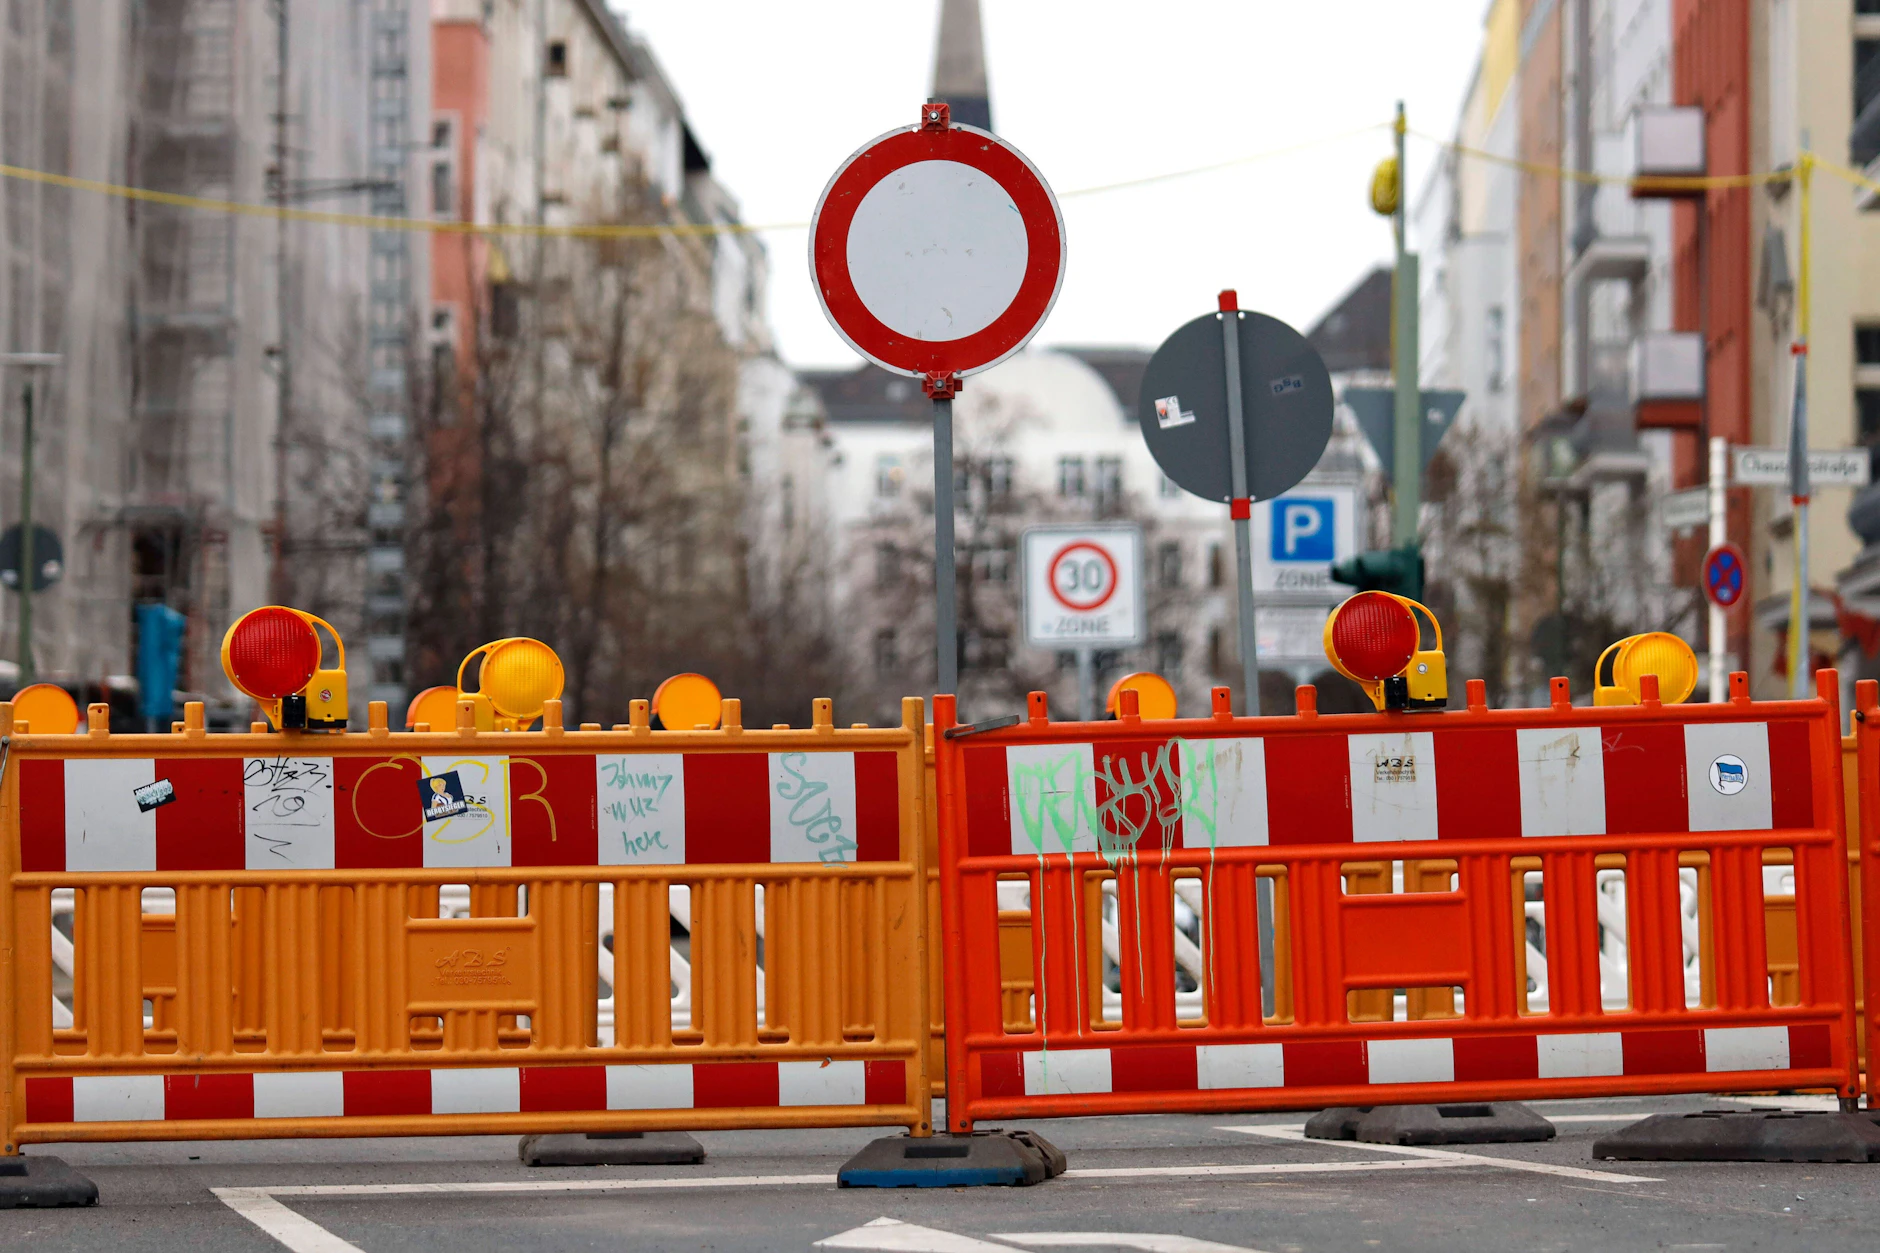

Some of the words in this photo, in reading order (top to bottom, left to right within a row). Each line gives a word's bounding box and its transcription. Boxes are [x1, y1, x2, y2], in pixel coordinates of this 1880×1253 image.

[1285, 505, 1321, 555] P
[1060, 559, 1103, 594] 30
[1274, 568, 1329, 589] ZONE
[1055, 615, 1109, 635] ZONE
[1376, 758, 1414, 767] ABS
[426, 801, 466, 818] DERBYSIEGER
[622, 830, 669, 856] here
[435, 949, 507, 968] ABS
